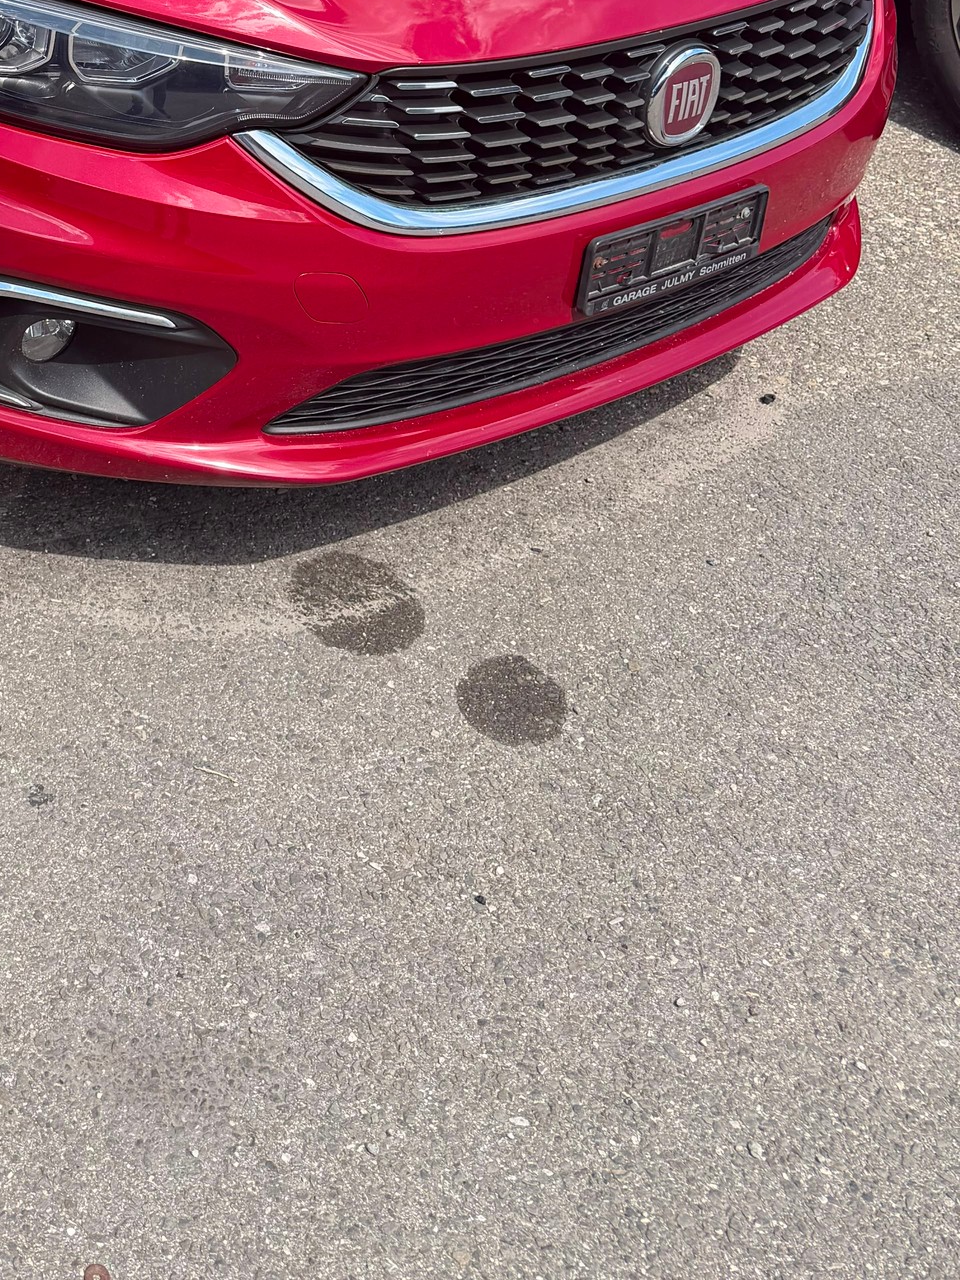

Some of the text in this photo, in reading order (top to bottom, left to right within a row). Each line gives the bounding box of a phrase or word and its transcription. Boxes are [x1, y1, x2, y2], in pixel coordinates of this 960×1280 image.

[667, 73, 711, 124] FIAT
[613, 252, 747, 307] GARAGE JULMY Schmitten
